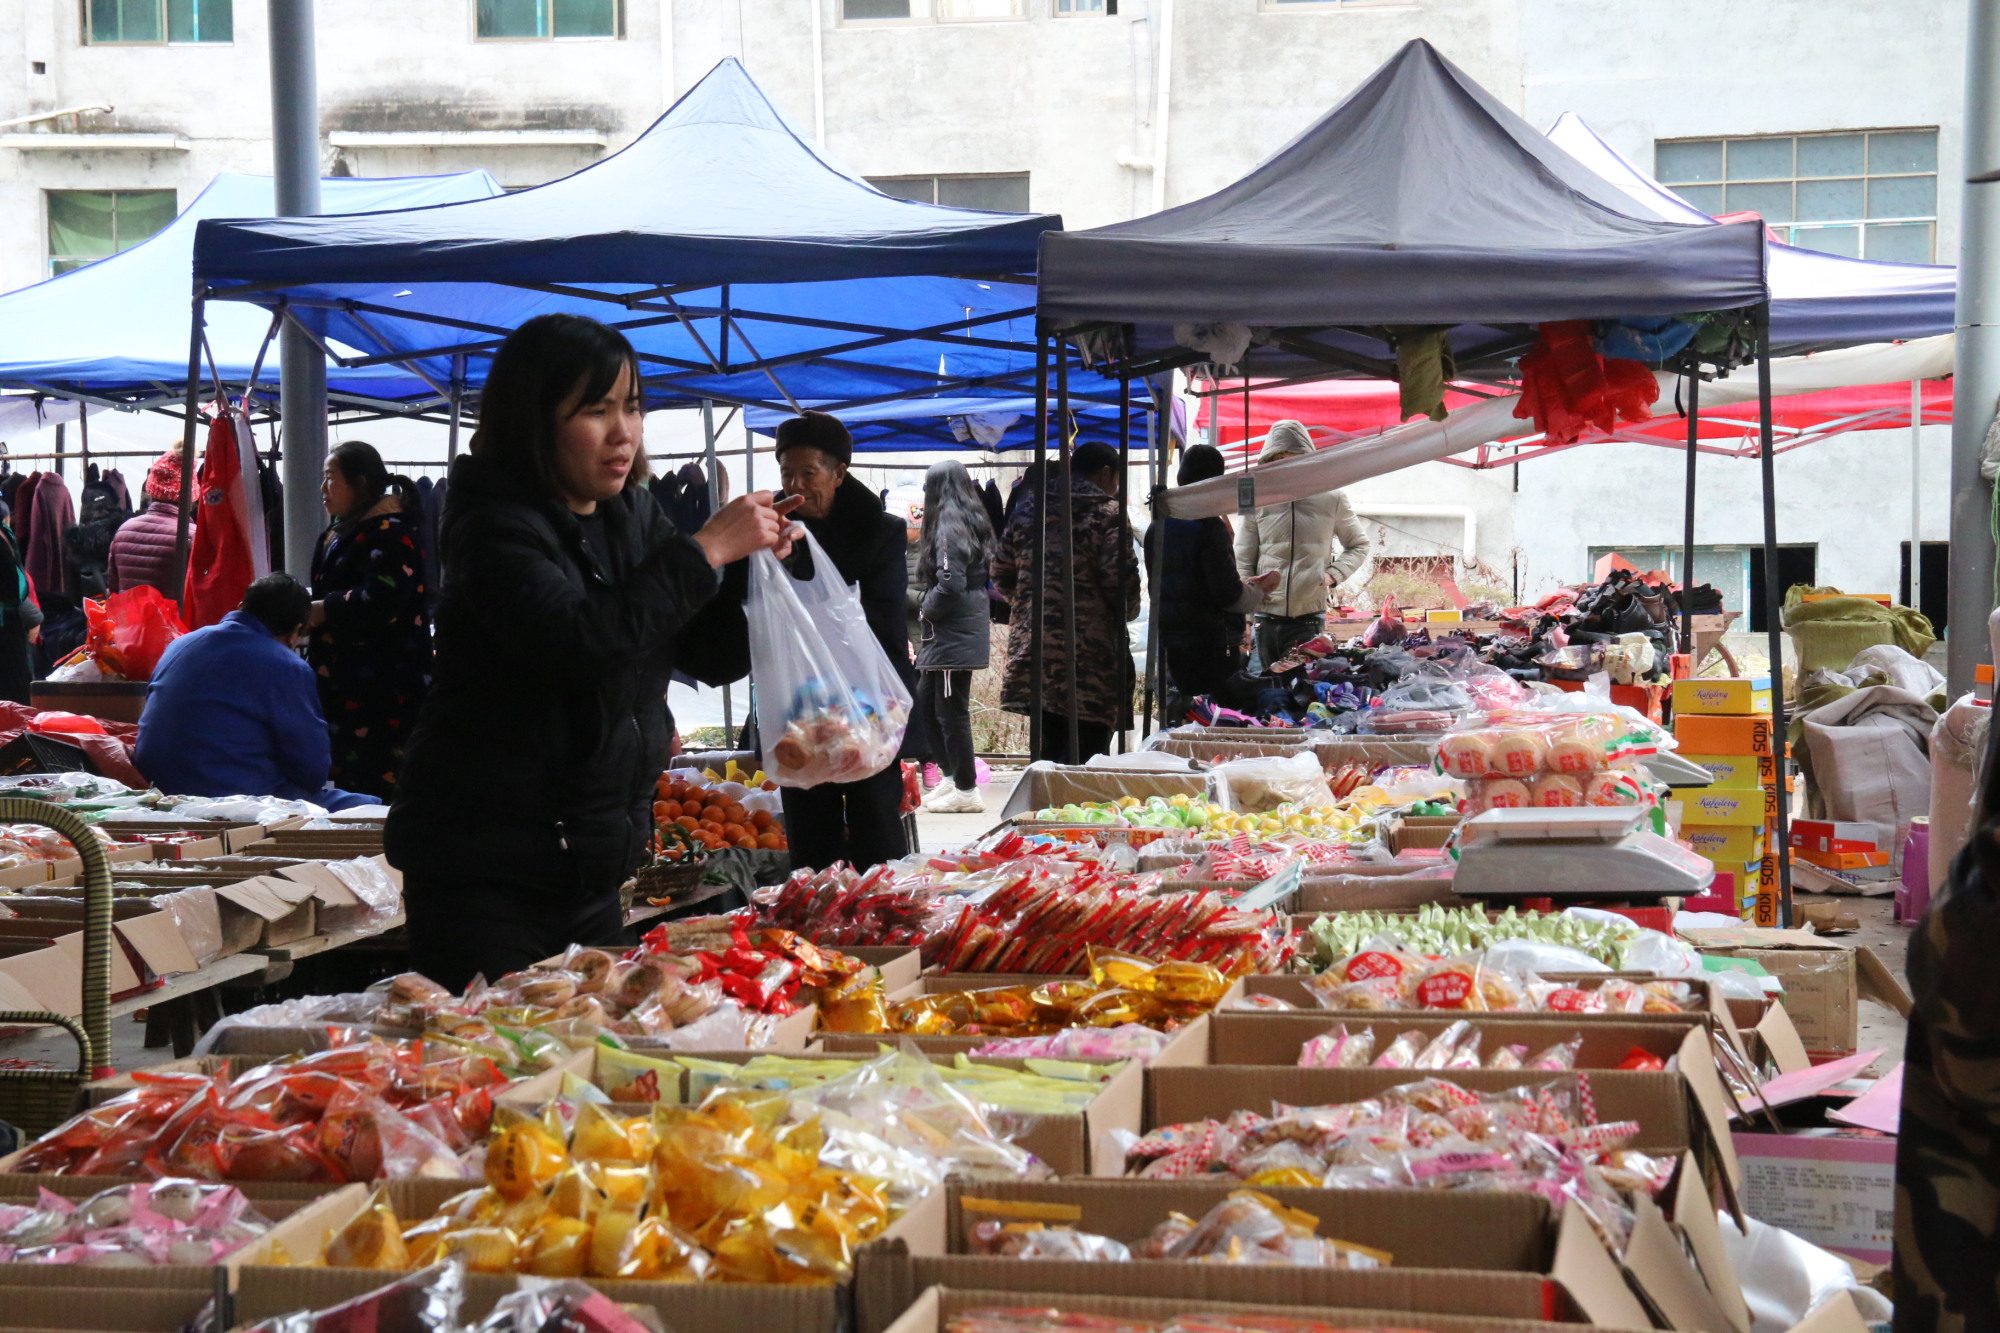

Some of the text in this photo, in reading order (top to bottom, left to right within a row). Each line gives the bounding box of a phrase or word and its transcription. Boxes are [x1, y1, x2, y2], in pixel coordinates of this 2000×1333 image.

[1753, 722, 1767, 752] KIDS
[1762, 756, 1772, 777] IDS
[1764, 783, 1776, 813] KIDS
[1761, 856, 1774, 886] KIDS
[1760, 893, 1772, 923] KIDS
